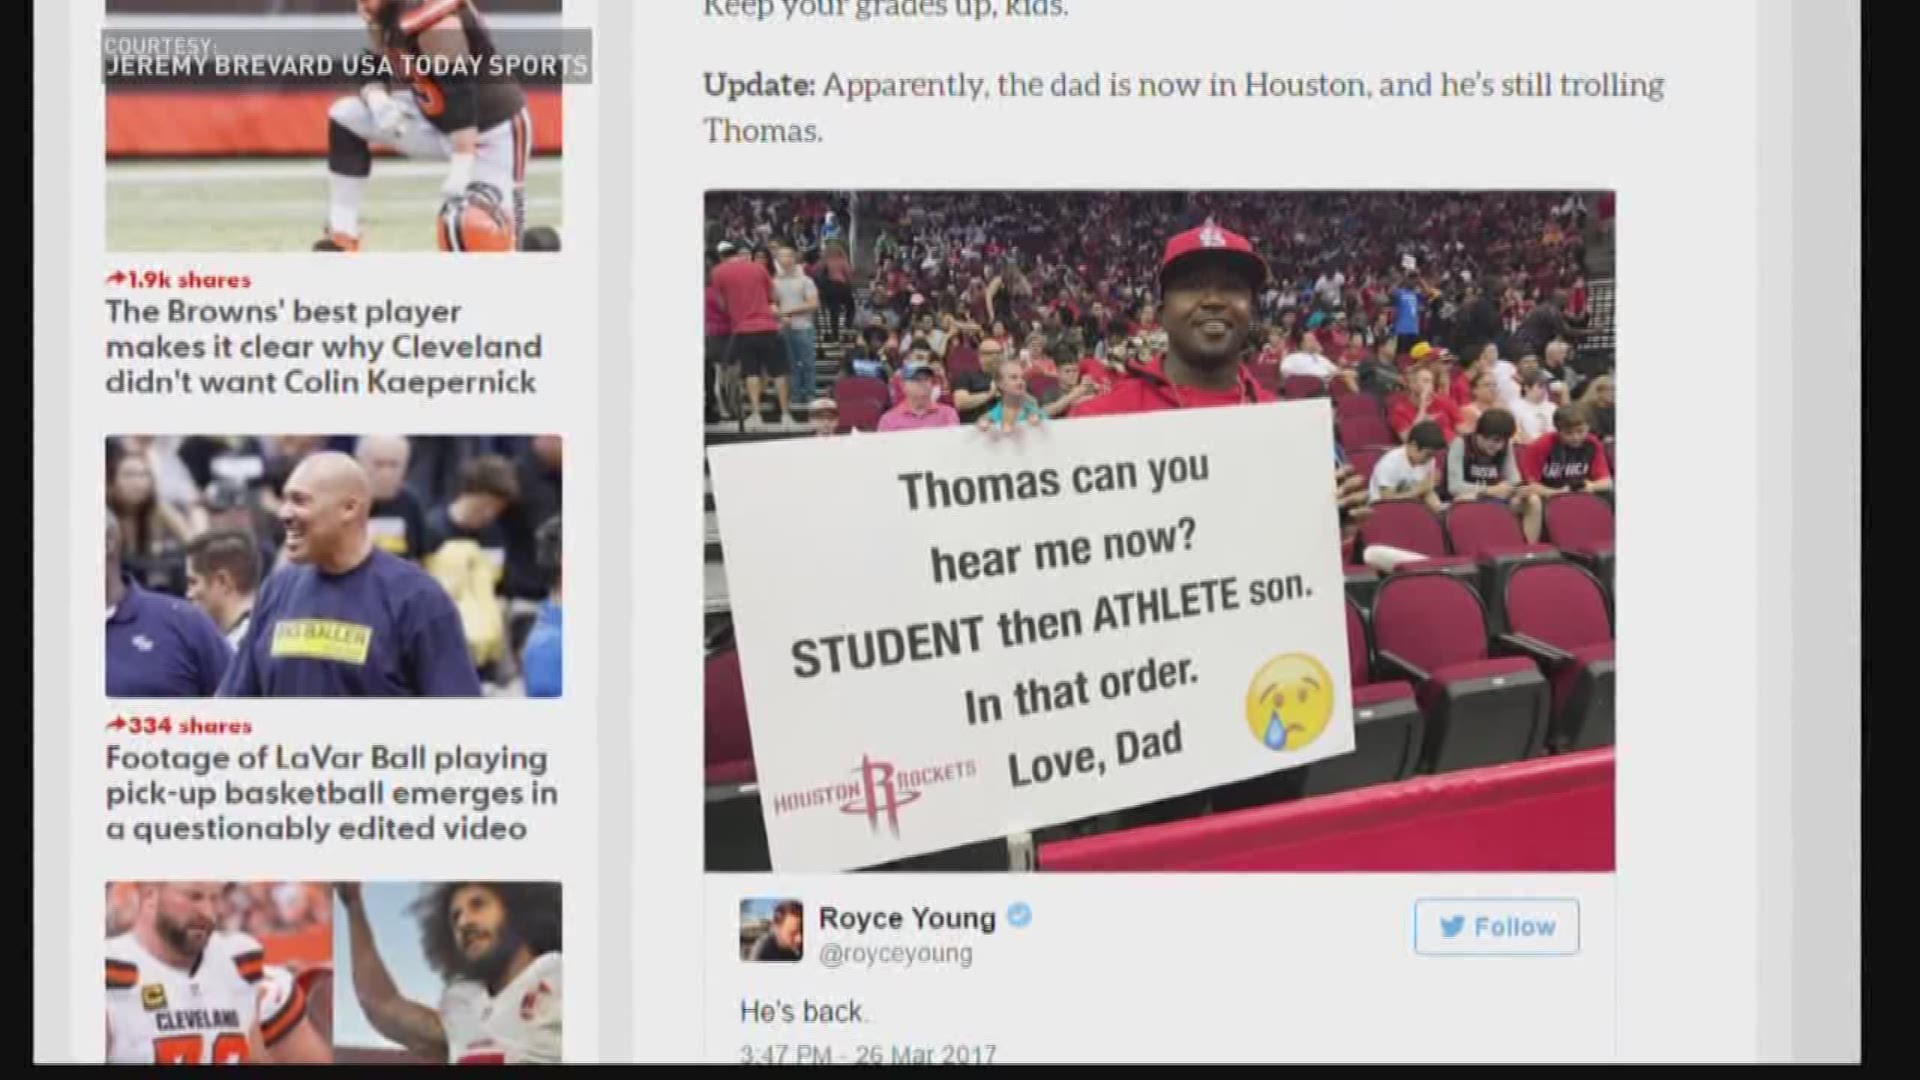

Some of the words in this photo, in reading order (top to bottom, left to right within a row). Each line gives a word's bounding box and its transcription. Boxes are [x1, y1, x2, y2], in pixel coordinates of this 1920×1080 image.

[703, 0, 775, 22] Keep
[782, 0, 850, 21] your
[855, 0, 949, 21] grades
[956, 0, 998, 21] up,
[1006, 0, 1070, 17] kids.
[703, 71, 816, 102] Update:
[823, 72, 990, 102] Apparently,
[998, 72, 1044, 97] the
[1050, 72, 1101, 97] dad
[1110, 72, 1132, 97] is
[1139, 78, 1202, 97] now
[1210, 72, 1237, 97] in
[1245, 72, 1373, 100] Houston,
[1380, 72, 1432, 97] and
[1502, 72, 1552, 97] still
[1560, 72, 1666, 103] trolling
[703, 116, 823, 144] Thomas.
[129, 270, 172, 289] 1.9k
[178, 270, 252, 289] shares
[105, 299, 161, 324] The
[168, 299, 285, 324] Browns'
[293, 299, 358, 324] best
[365, 299, 463, 330] player
[106, 333, 207, 360] makes
[213, 334, 233, 360] it
[239, 333, 315, 360] clear
[321, 334, 386, 365] why
[391, 334, 543, 360] Cleveland
[105, 368, 193, 395] didn't
[199, 372, 278, 395] want
[284, 367, 360, 395] Colin
[367, 368, 537, 400] Kaepernick
[898, 468, 1061, 511] Thomas
[1072, 462, 1137, 494] can
[1148, 454, 1209, 495] you
[930, 545, 1021, 584] hear
[1034, 536, 1092, 570] me
[1103, 516, 1196, 560] now?
[791, 615, 984, 679] STUDENT
[996, 608, 1083, 648] then
[1093, 576, 1240, 632] ATHLETE
[1249, 574, 1313, 606] son.
[965, 690, 1002, 726] In
[1014, 672, 1089, 716] that
[1100, 657, 1199, 701] order.
[128, 716, 173, 736] 334
[178, 716, 253, 735] shares
[106, 745, 231, 778] Footage
[238, 744, 270, 770] of
[276, 745, 364, 770] LaVar
[371, 744, 427, 770] Ball
[434, 744, 548, 778] playing
[1008, 746, 1106, 788] Love,
[1115, 720, 1183, 765] Dad
[106, 780, 217, 811] pick-up
[225, 779, 384, 805] basketball
[391, 786, 525, 811] emerges
[531, 779, 558, 805] in
[774, 781, 860, 815] HOUSTON
[106, 822, 125, 841] a
[133, 814, 332, 846] questionably
[338, 814, 436, 841] edited
[442, 814, 528, 841] video
[819, 906, 904, 936] Royce
[911, 906, 997, 936] Young
[1475, 916, 1557, 938] Follow
[819, 943, 973, 970] @royceyoung
[740, 999, 795, 1024] He's
[740, 1044, 789, 1064] 3:47
[796, 1044, 832, 1064] PM
[854, 1044, 884, 1064] 26
[890, 1044, 935, 1064] Mar
[942, 1044, 997, 1064] 2017
